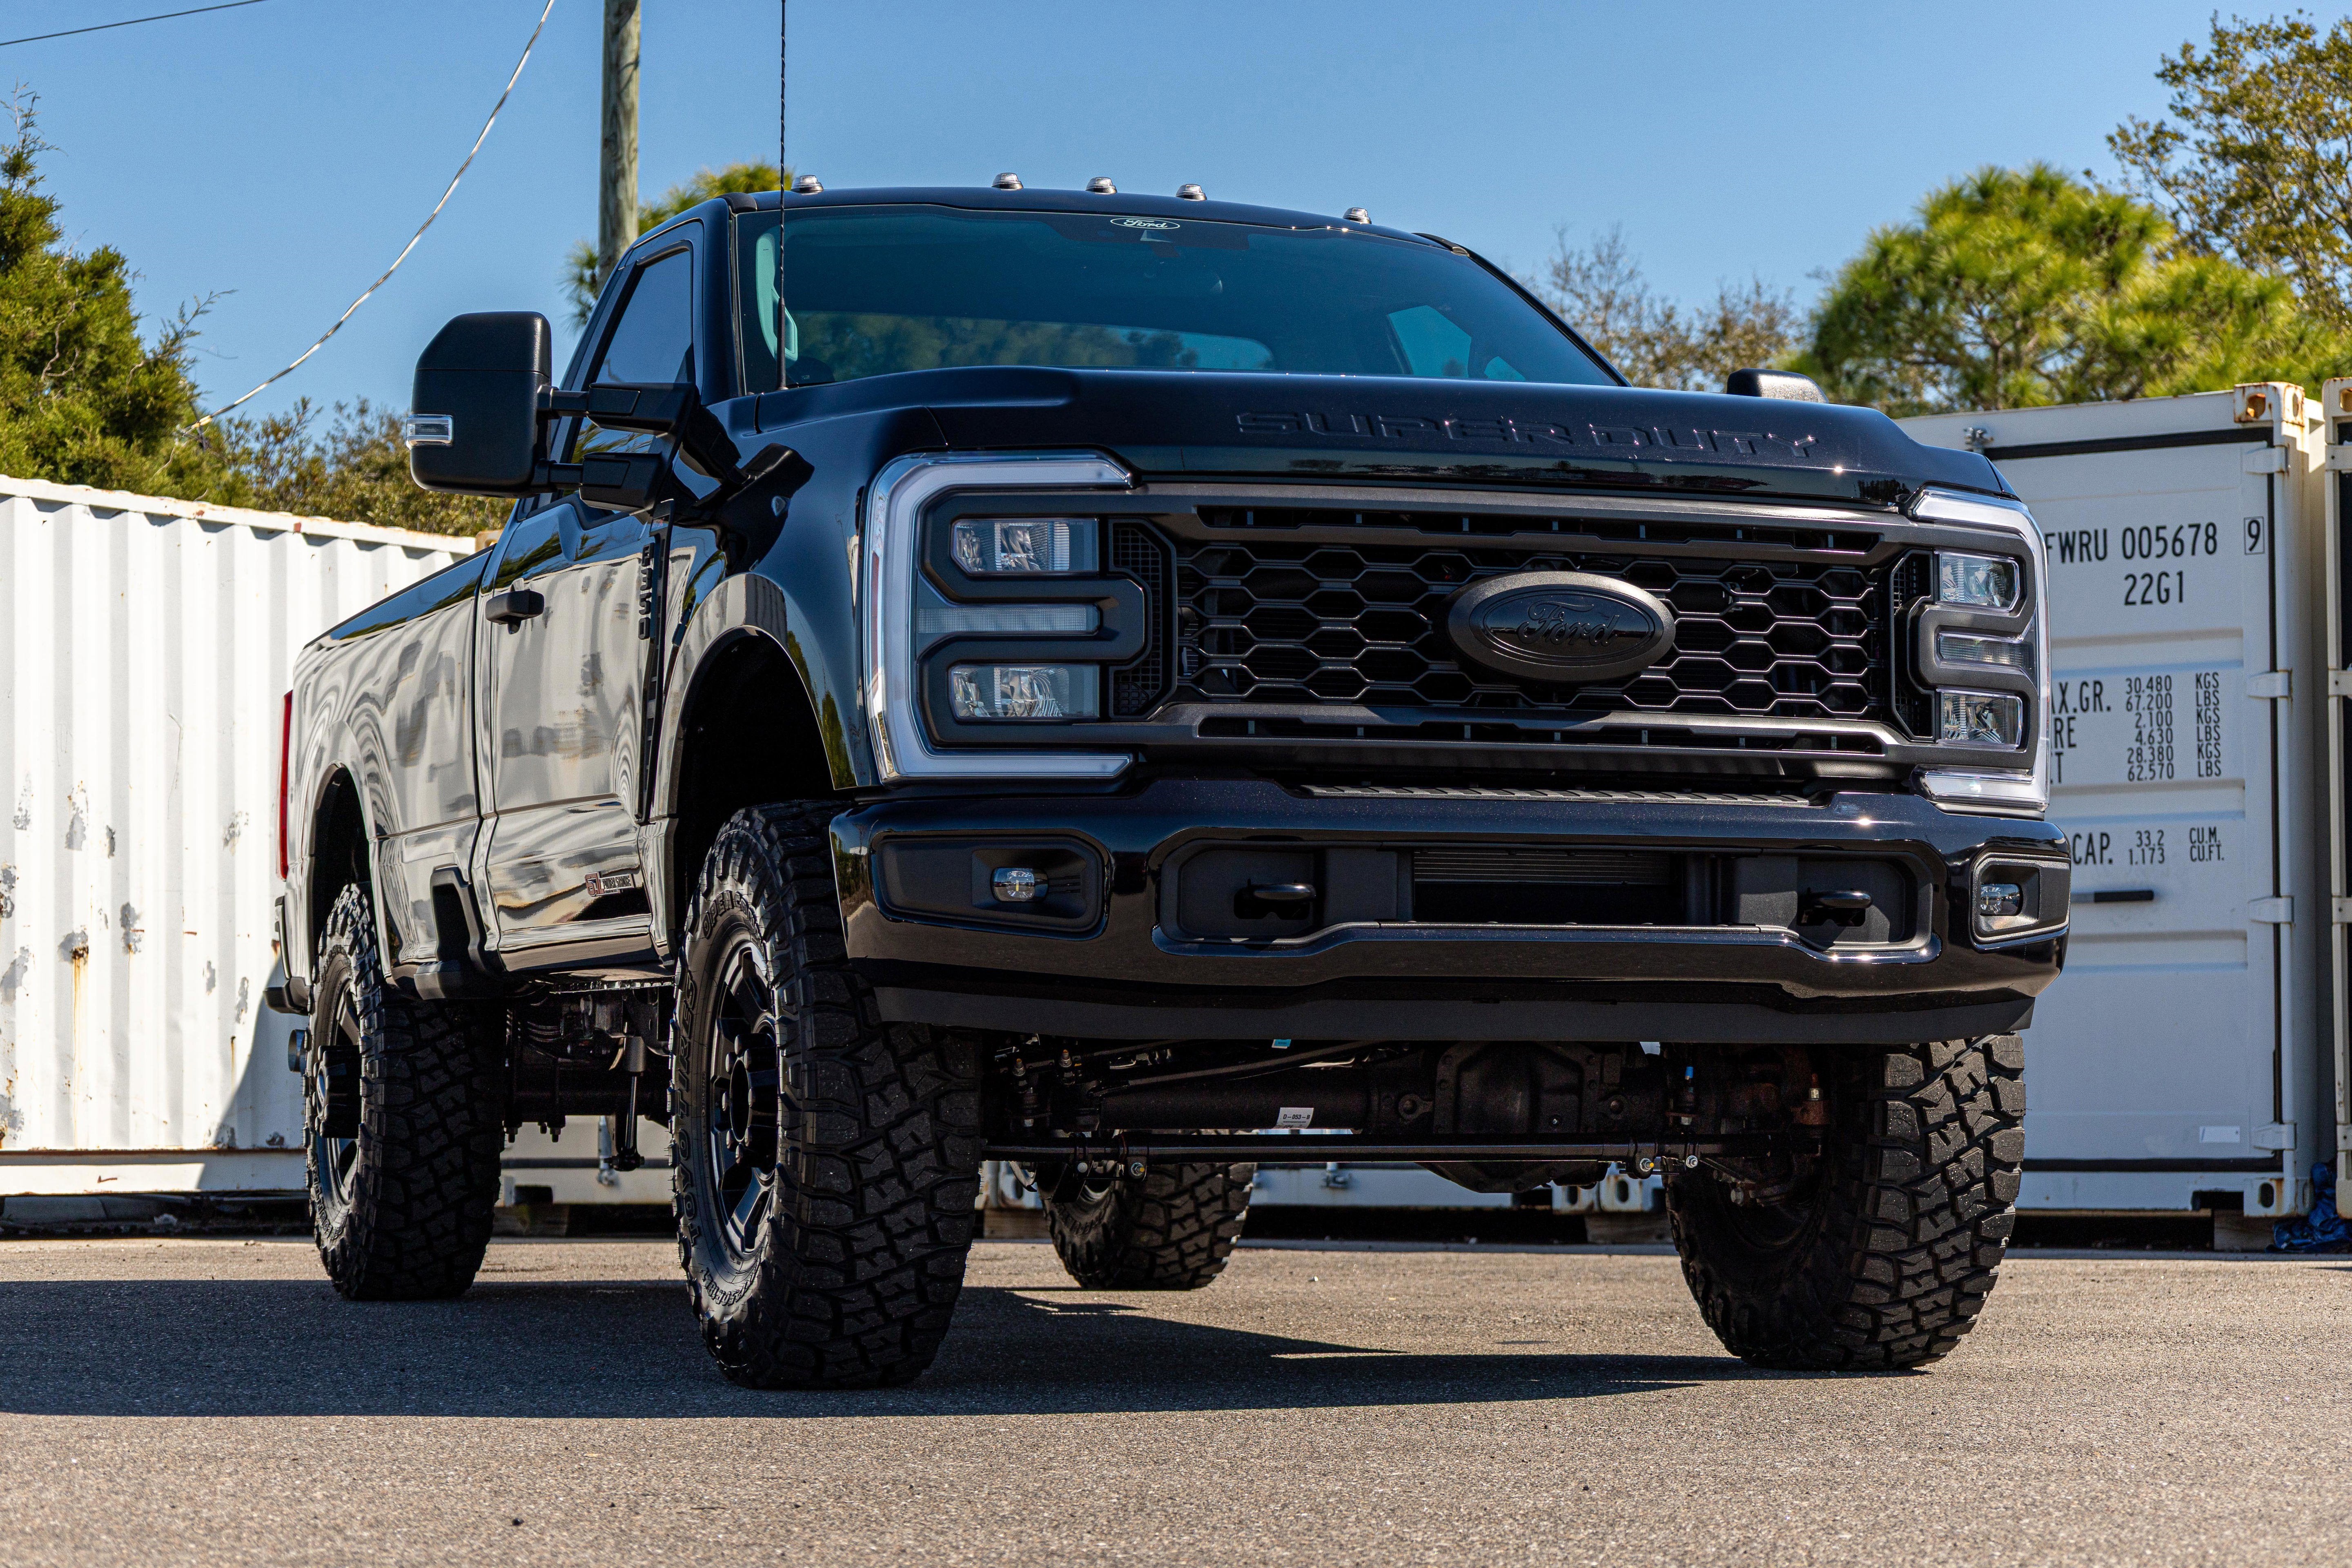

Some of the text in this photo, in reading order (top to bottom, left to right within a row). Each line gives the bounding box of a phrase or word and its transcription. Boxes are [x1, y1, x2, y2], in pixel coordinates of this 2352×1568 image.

[1123, 218, 1167, 228] Ford
[1237, 412, 1820, 458] SUPER DUTY
[2045, 519, 2261, 564] FWRU 005678 9
[2124, 570, 2183, 606] 22G1
[1518, 600, 1620, 647] Ford
[2051, 672, 2219, 714] X.GR. 30.480 KGS
[2126, 690, 2220, 712] 67.200 LBS
[2051, 707, 2221, 749] RE 2.100 KGS
[2135, 725, 2221, 746] 4.630 LBS
[2127, 742, 2221, 764] 28.380 KGS
[2128, 760, 2222, 782] 62.570 LBS
[2072, 826, 2221, 865] CAP. 33.2 CU.M.
[2129, 844, 2225, 865] 1.173 CU.FT.
[677, 970, 700, 1246] TOYO TIRES
